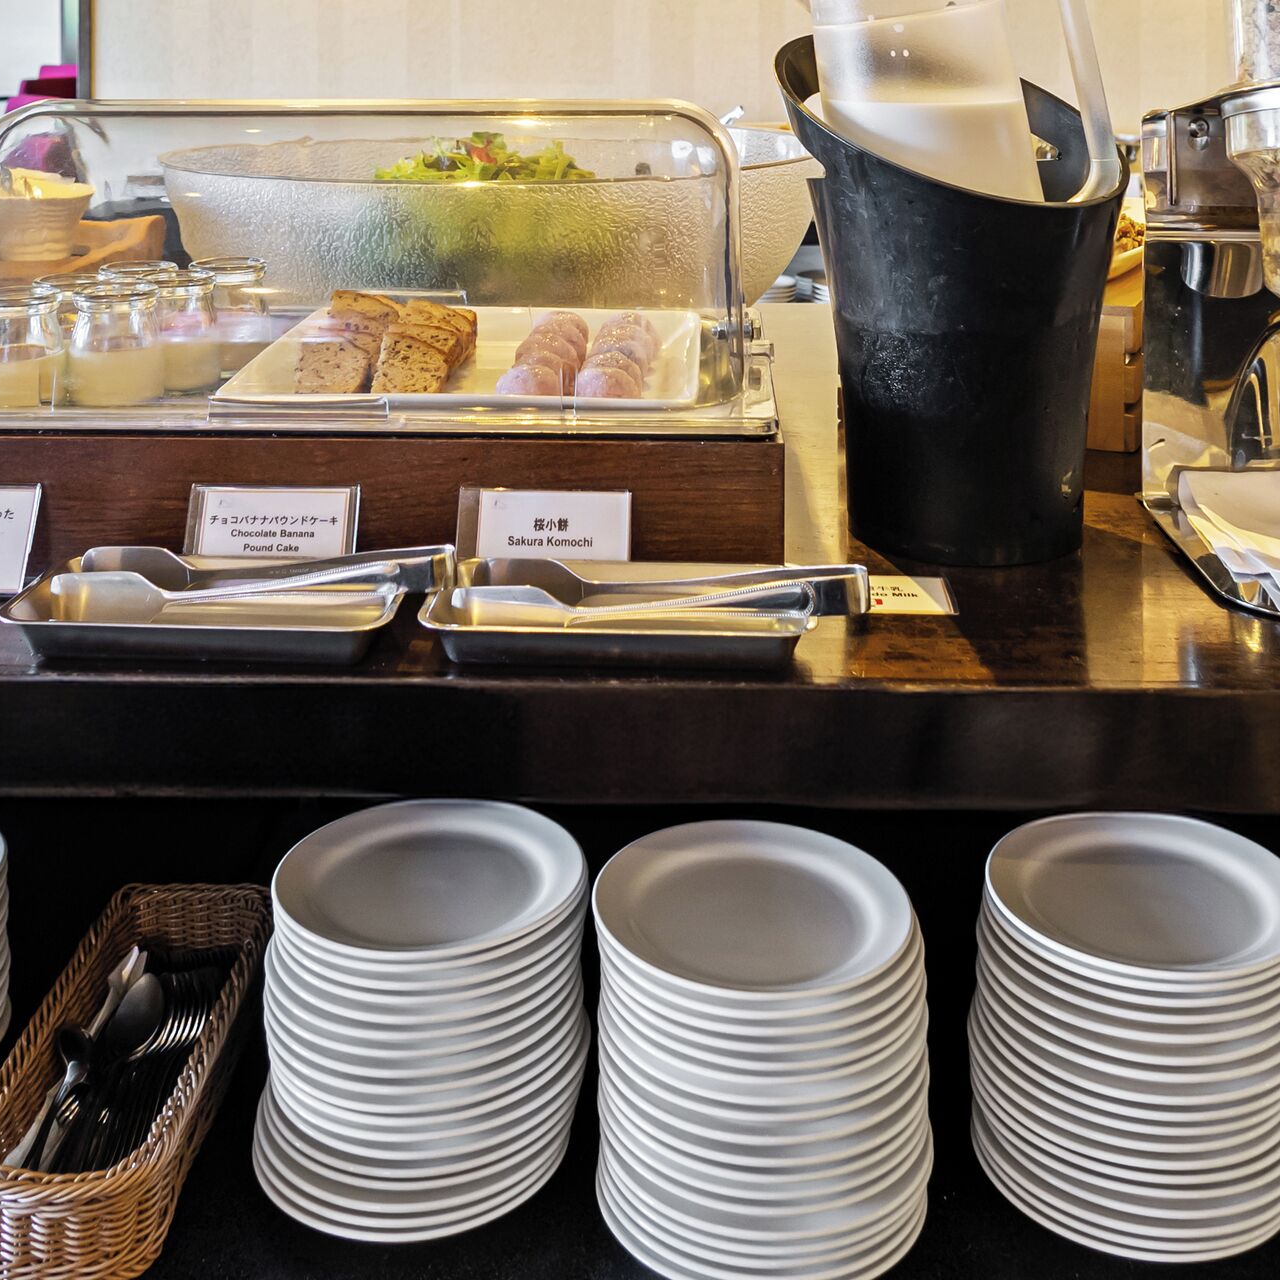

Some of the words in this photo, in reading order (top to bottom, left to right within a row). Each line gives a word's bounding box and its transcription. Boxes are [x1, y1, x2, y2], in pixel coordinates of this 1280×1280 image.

[533, 517, 569, 532] 桜小餅
[230, 528, 277, 538] Chocolate
[280, 529, 315, 538] Banana
[507, 535, 543, 547] Sakura
[546, 536, 593, 548] Komochi
[243, 543, 273, 552] Pound
[276, 543, 300, 552] Cake
